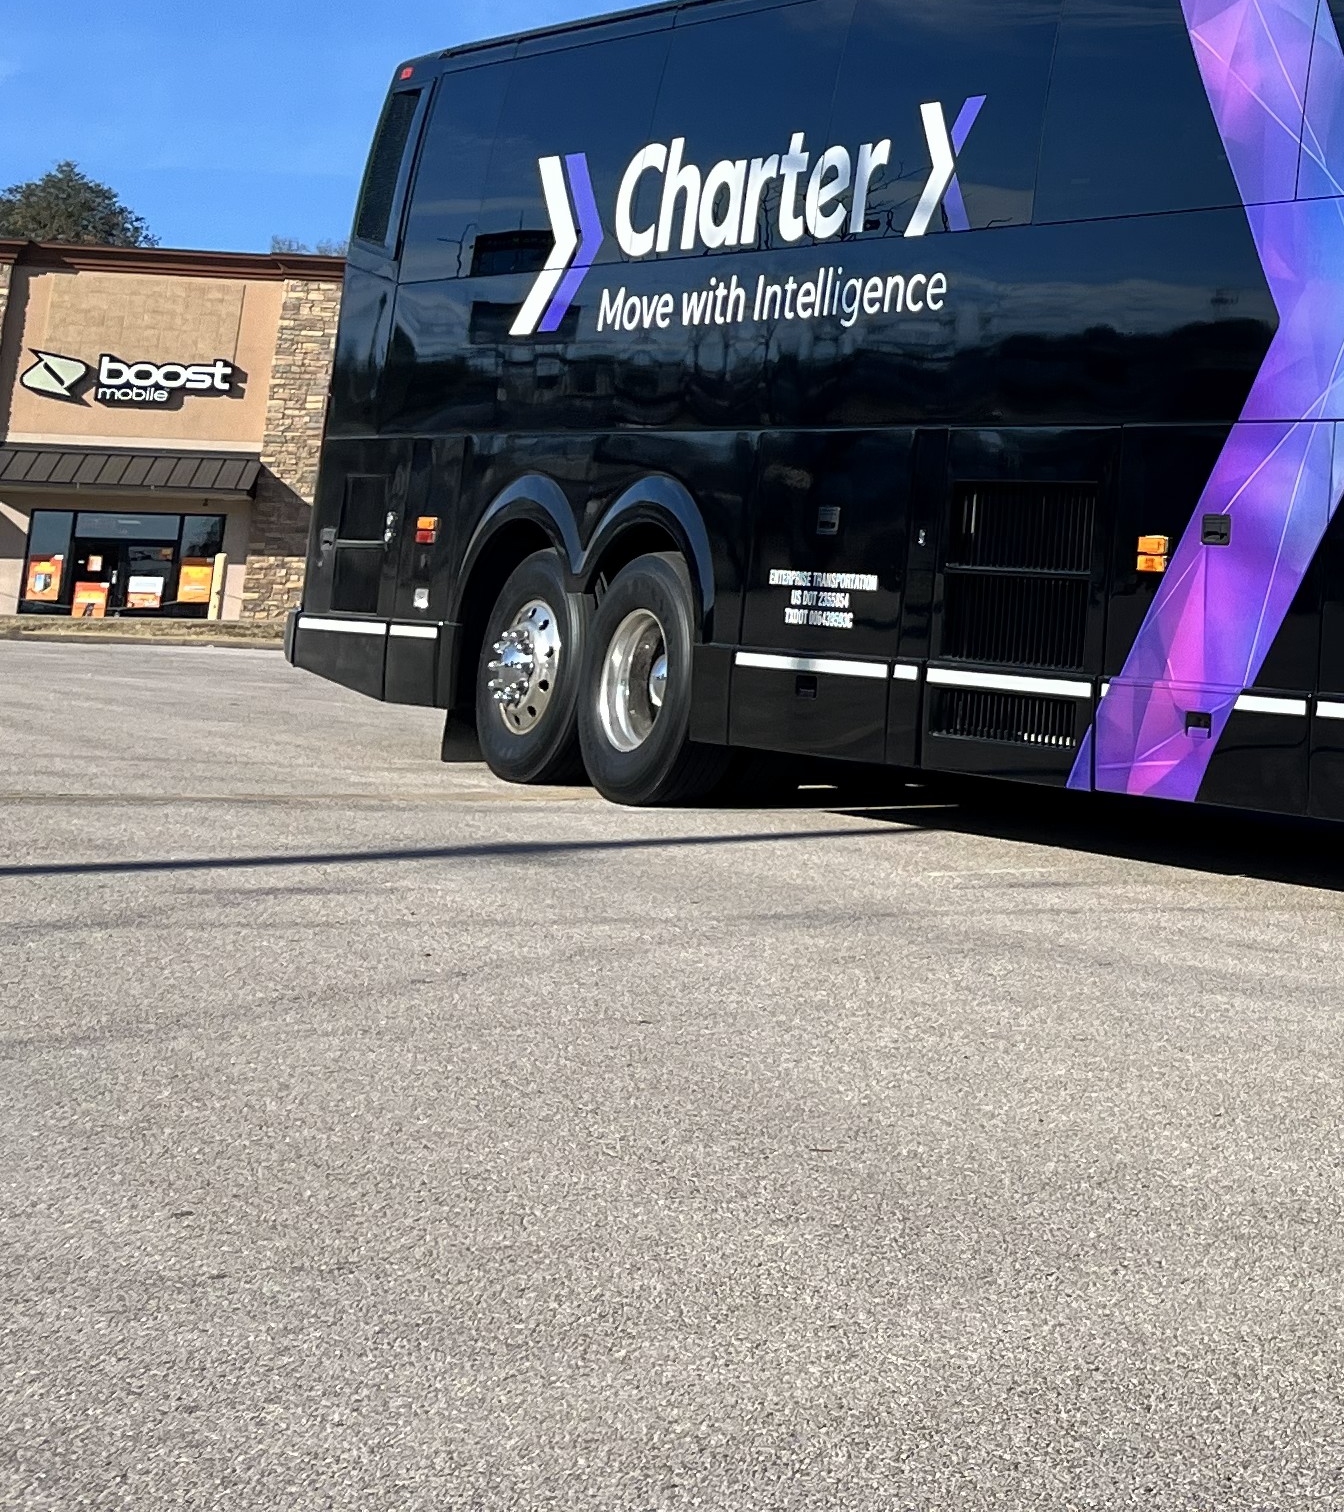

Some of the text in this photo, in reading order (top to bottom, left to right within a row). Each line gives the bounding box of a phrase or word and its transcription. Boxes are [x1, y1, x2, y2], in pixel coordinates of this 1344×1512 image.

[615, 94, 987, 257] Charter X
[596, 266, 947, 332] Move with Intelligence
[99, 356, 232, 390] boost
[97, 387, 168, 402] mobile
[768, 569, 878, 591] ENTERPRISE TRANSPORTATION
[790, 589, 802, 605] US
[802, 590, 818, 606] DOT
